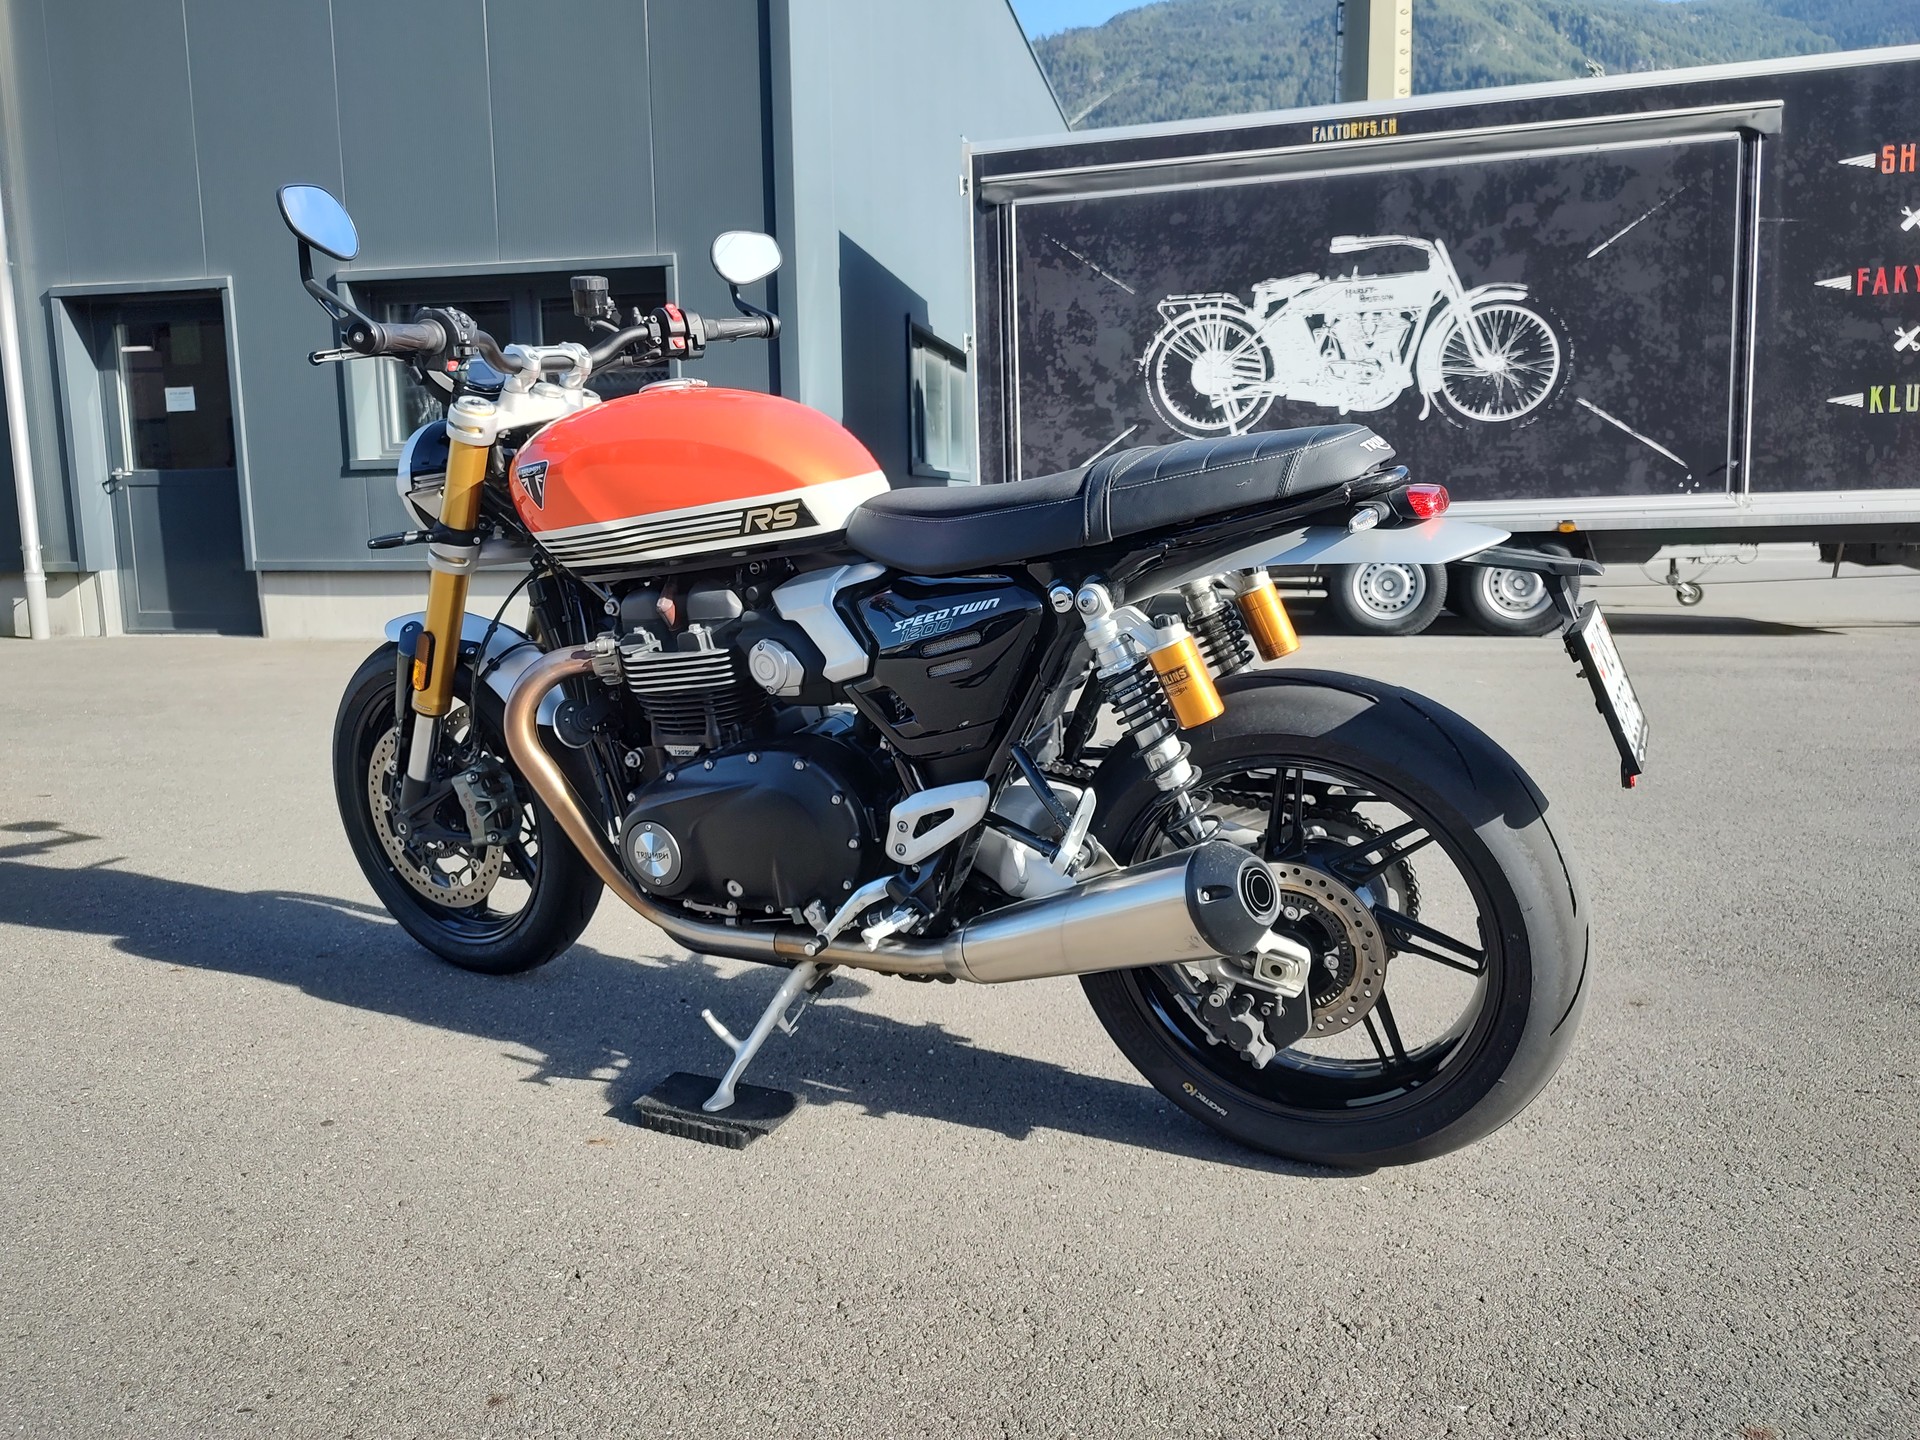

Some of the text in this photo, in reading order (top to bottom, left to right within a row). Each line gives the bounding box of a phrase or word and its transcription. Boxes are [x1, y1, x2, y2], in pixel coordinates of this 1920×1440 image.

[1881, 143, 1917, 174] SH
[1869, 384, 1920, 414] KLU
[744, 502, 800, 534] RS
[891, 597, 1001, 633] SPEED TWIN
[900, 617, 954, 643] 1200
[636, 850, 670, 861] TRIUMPH
[1196, 1091, 1228, 1117] RACETEC
